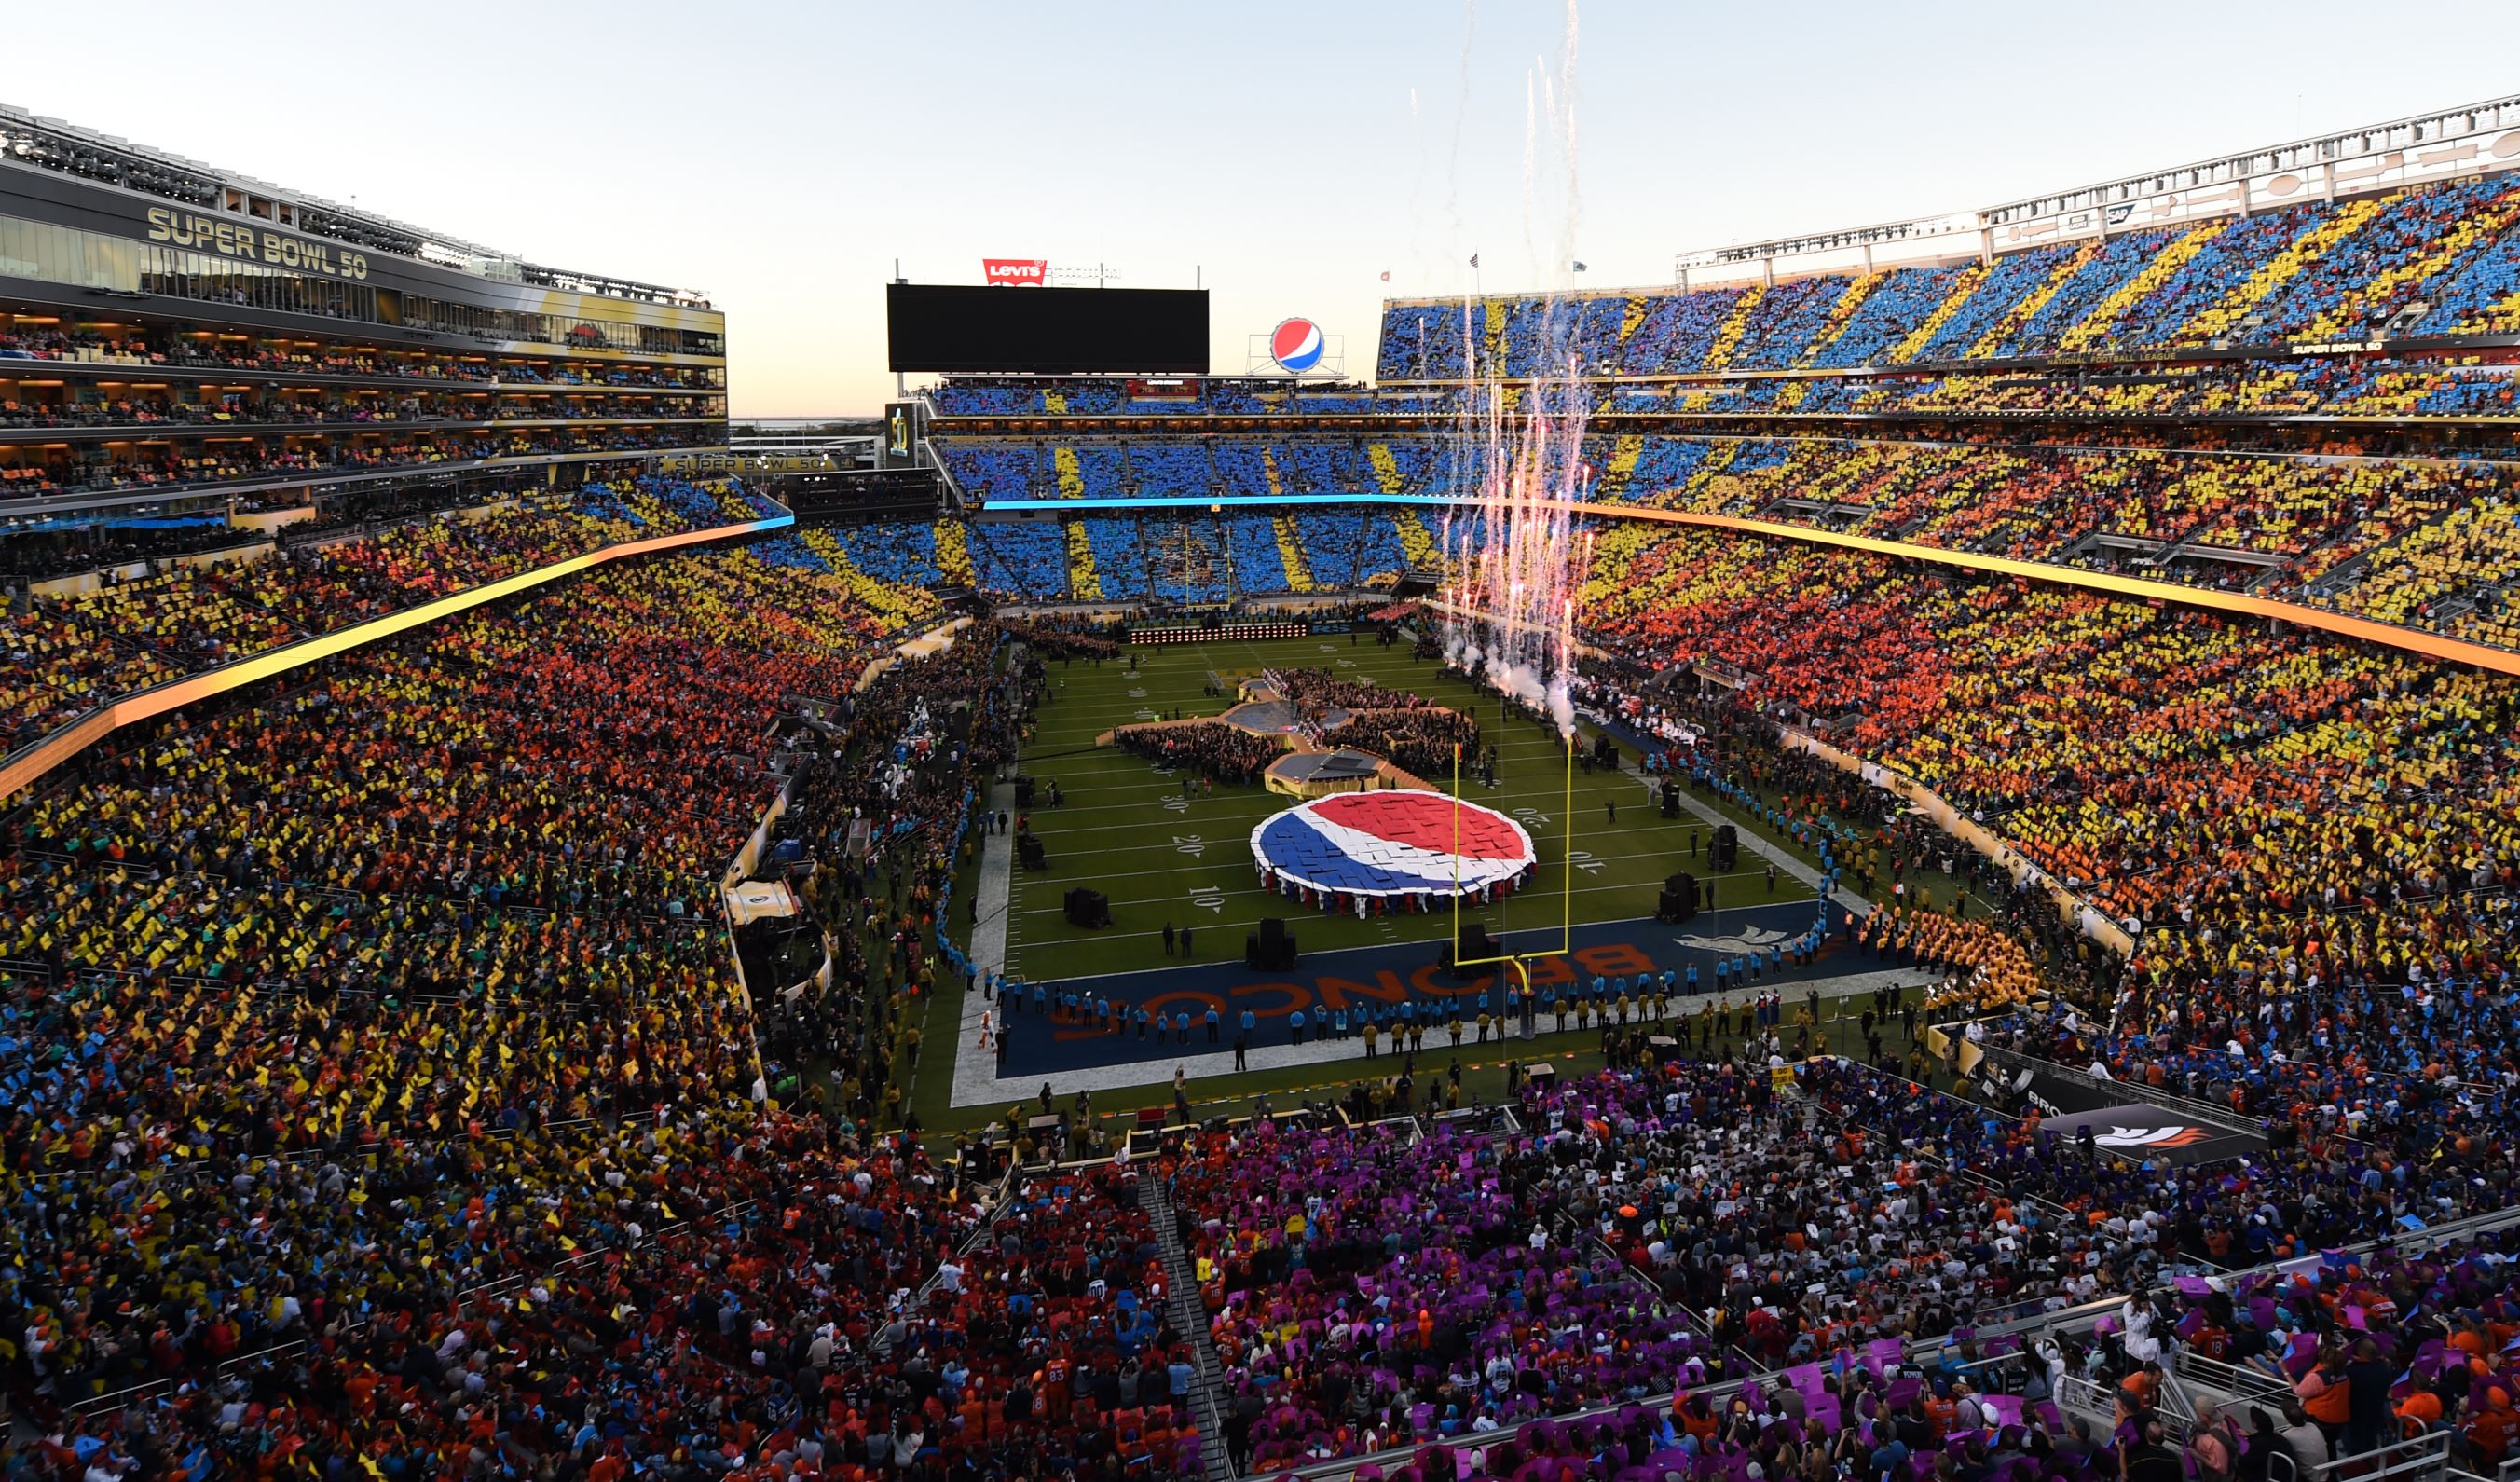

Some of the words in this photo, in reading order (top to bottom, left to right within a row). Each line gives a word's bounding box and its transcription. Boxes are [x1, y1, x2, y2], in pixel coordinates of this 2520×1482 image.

[2107, 208, 2129, 221] SAP
[147, 206, 257, 259] SUPER
[262, 232, 336, 275] BOWL
[339, 250, 368, 280] 50
[2292, 344, 2330, 355] SUPER
[2331, 342, 2365, 353] BOWL
[2365, 341, 2383, 351] 50
[2047, 357, 2087, 365] NATIONAL
[2090, 355, 2135, 364] FOOTBALL
[2139, 352, 2177, 362] LEAGUE
[674, 460, 736, 472] SUPER
[743, 459, 796, 471] BOWL
[801, 458, 822, 469] 50
[1512, 807, 1551, 824] 20
[1171, 834, 1206, 854] 20
[1564, 851, 1608, 869] 10
[1188, 885, 1226, 908] 10
[2211, 1341, 2223, 1355] 18
[1049, 1368, 1065, 1383] 83
